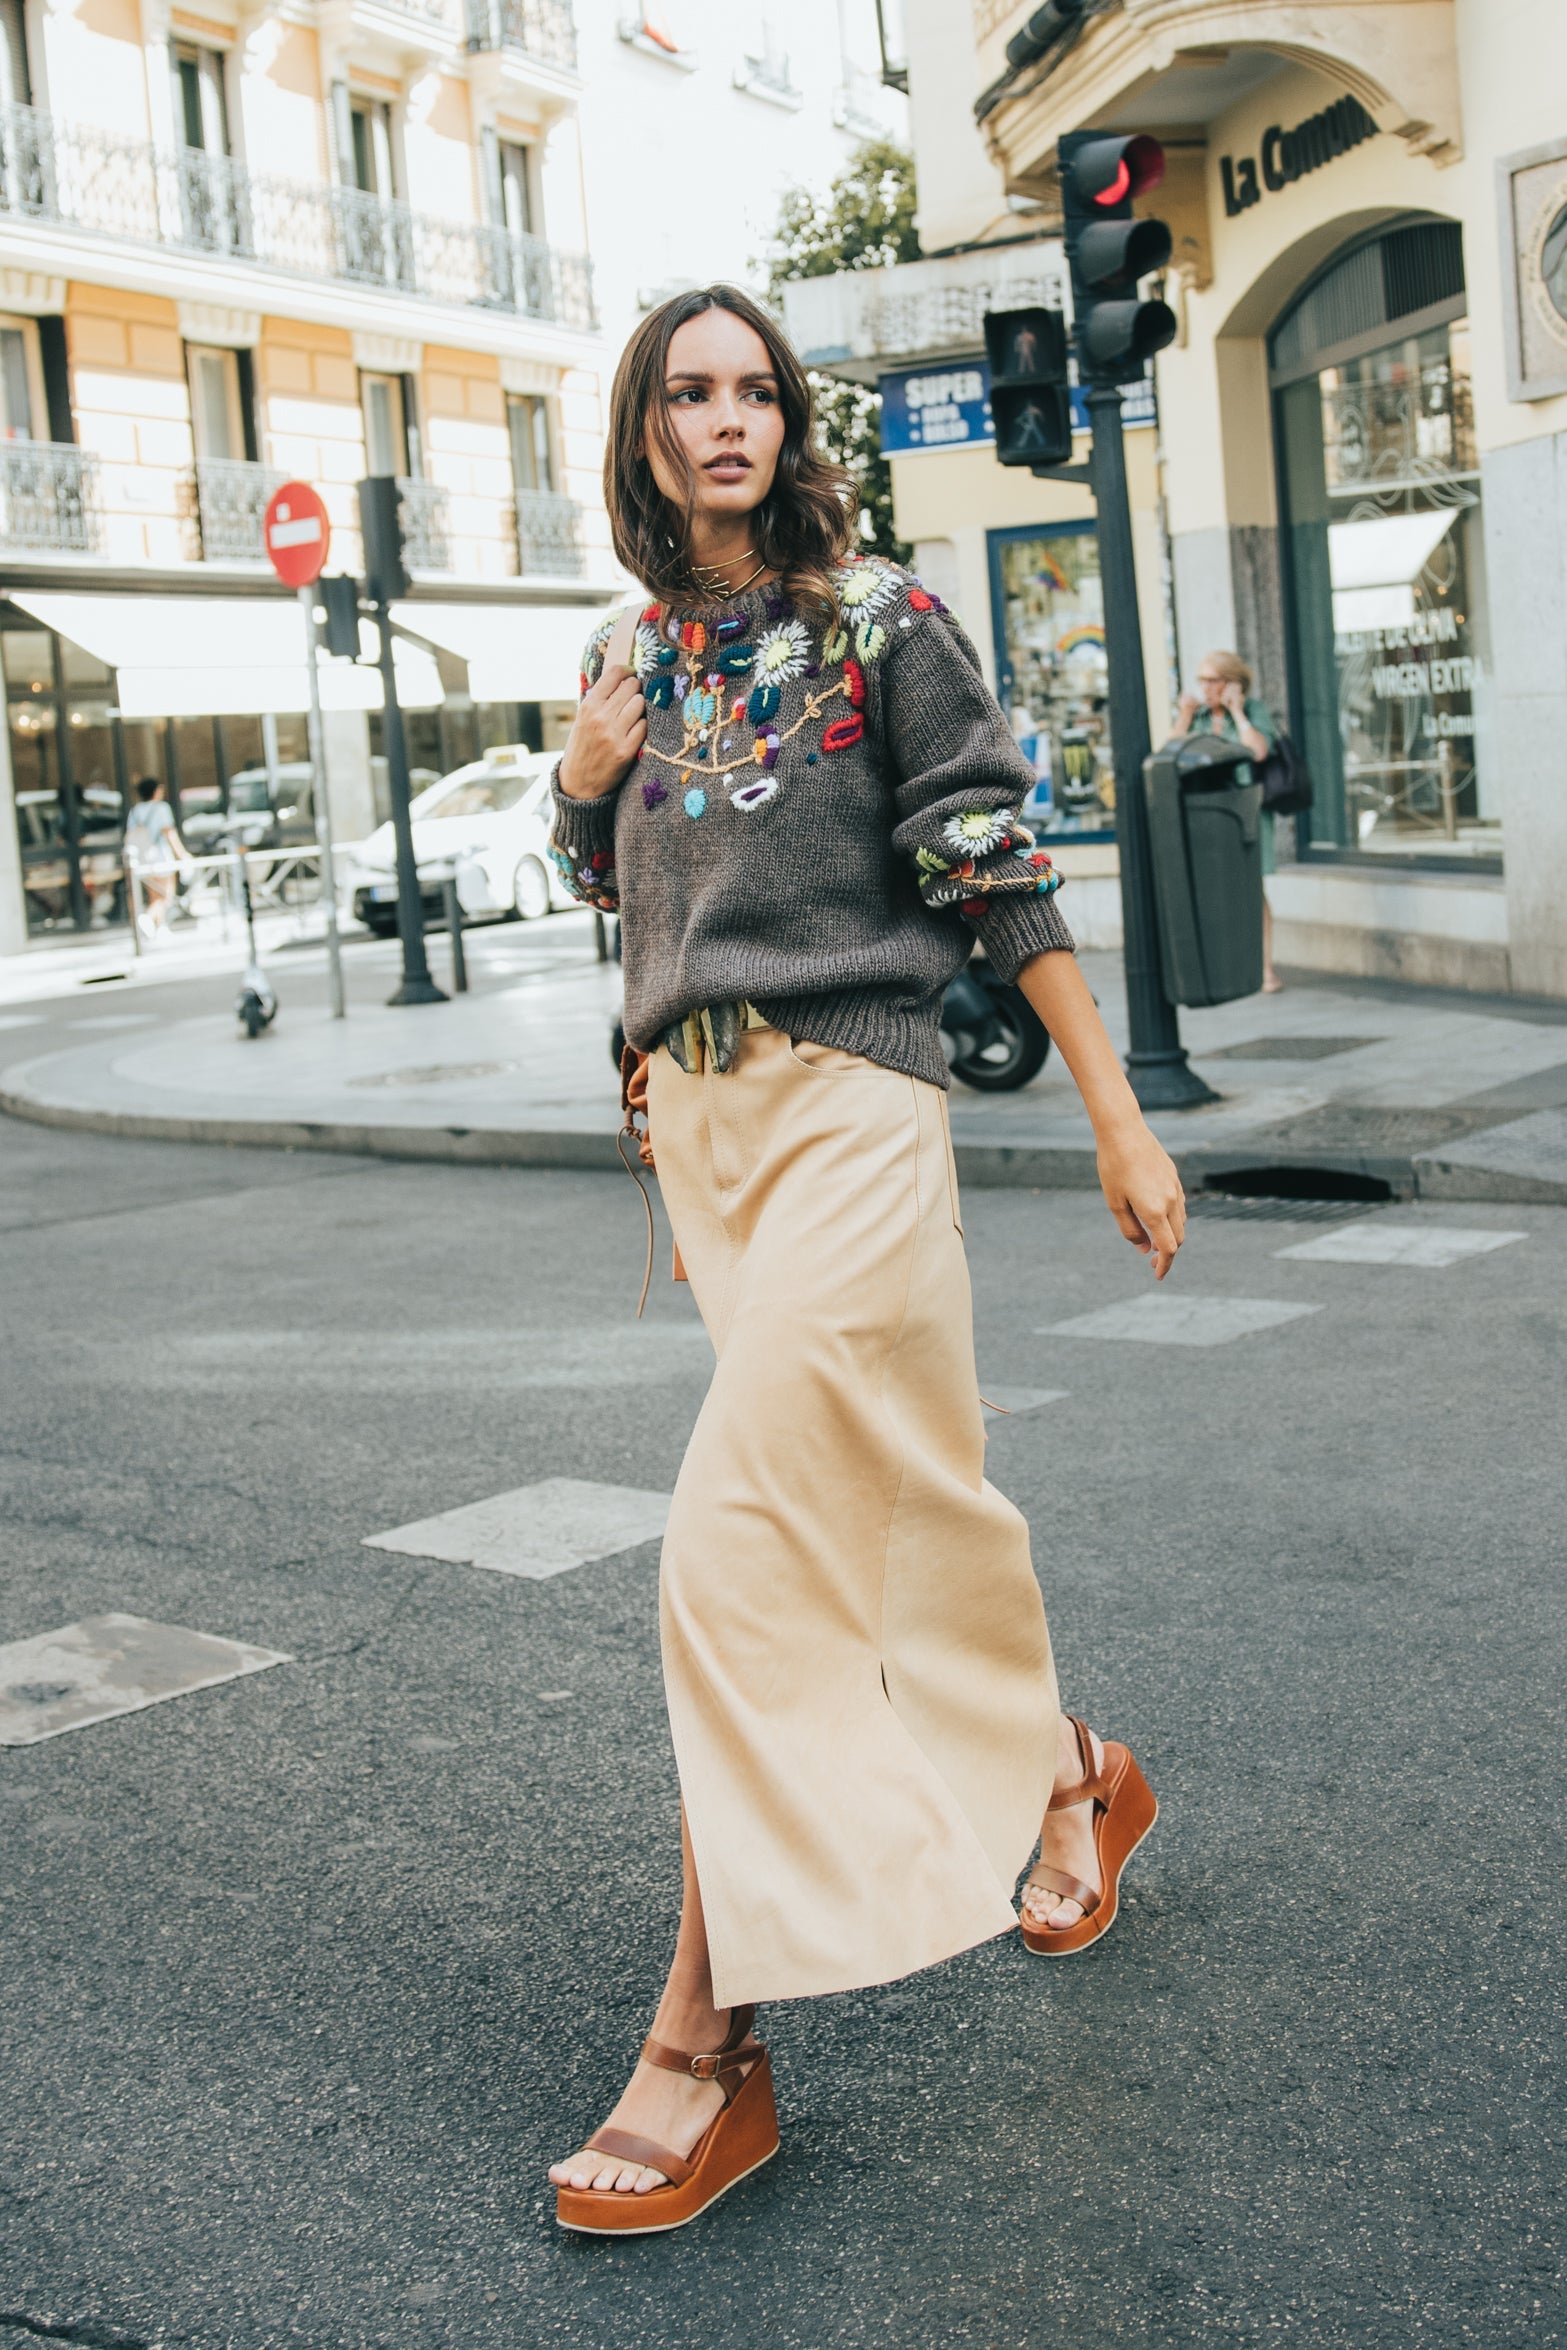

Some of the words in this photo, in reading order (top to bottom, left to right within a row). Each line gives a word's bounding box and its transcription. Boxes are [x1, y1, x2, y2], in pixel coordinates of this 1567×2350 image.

[1220, 154, 1261, 217] La
[904, 370, 984, 410] SUPER
[1372, 661, 1432, 700] VIRGEN
[1422, 712, 1439, 738] La
